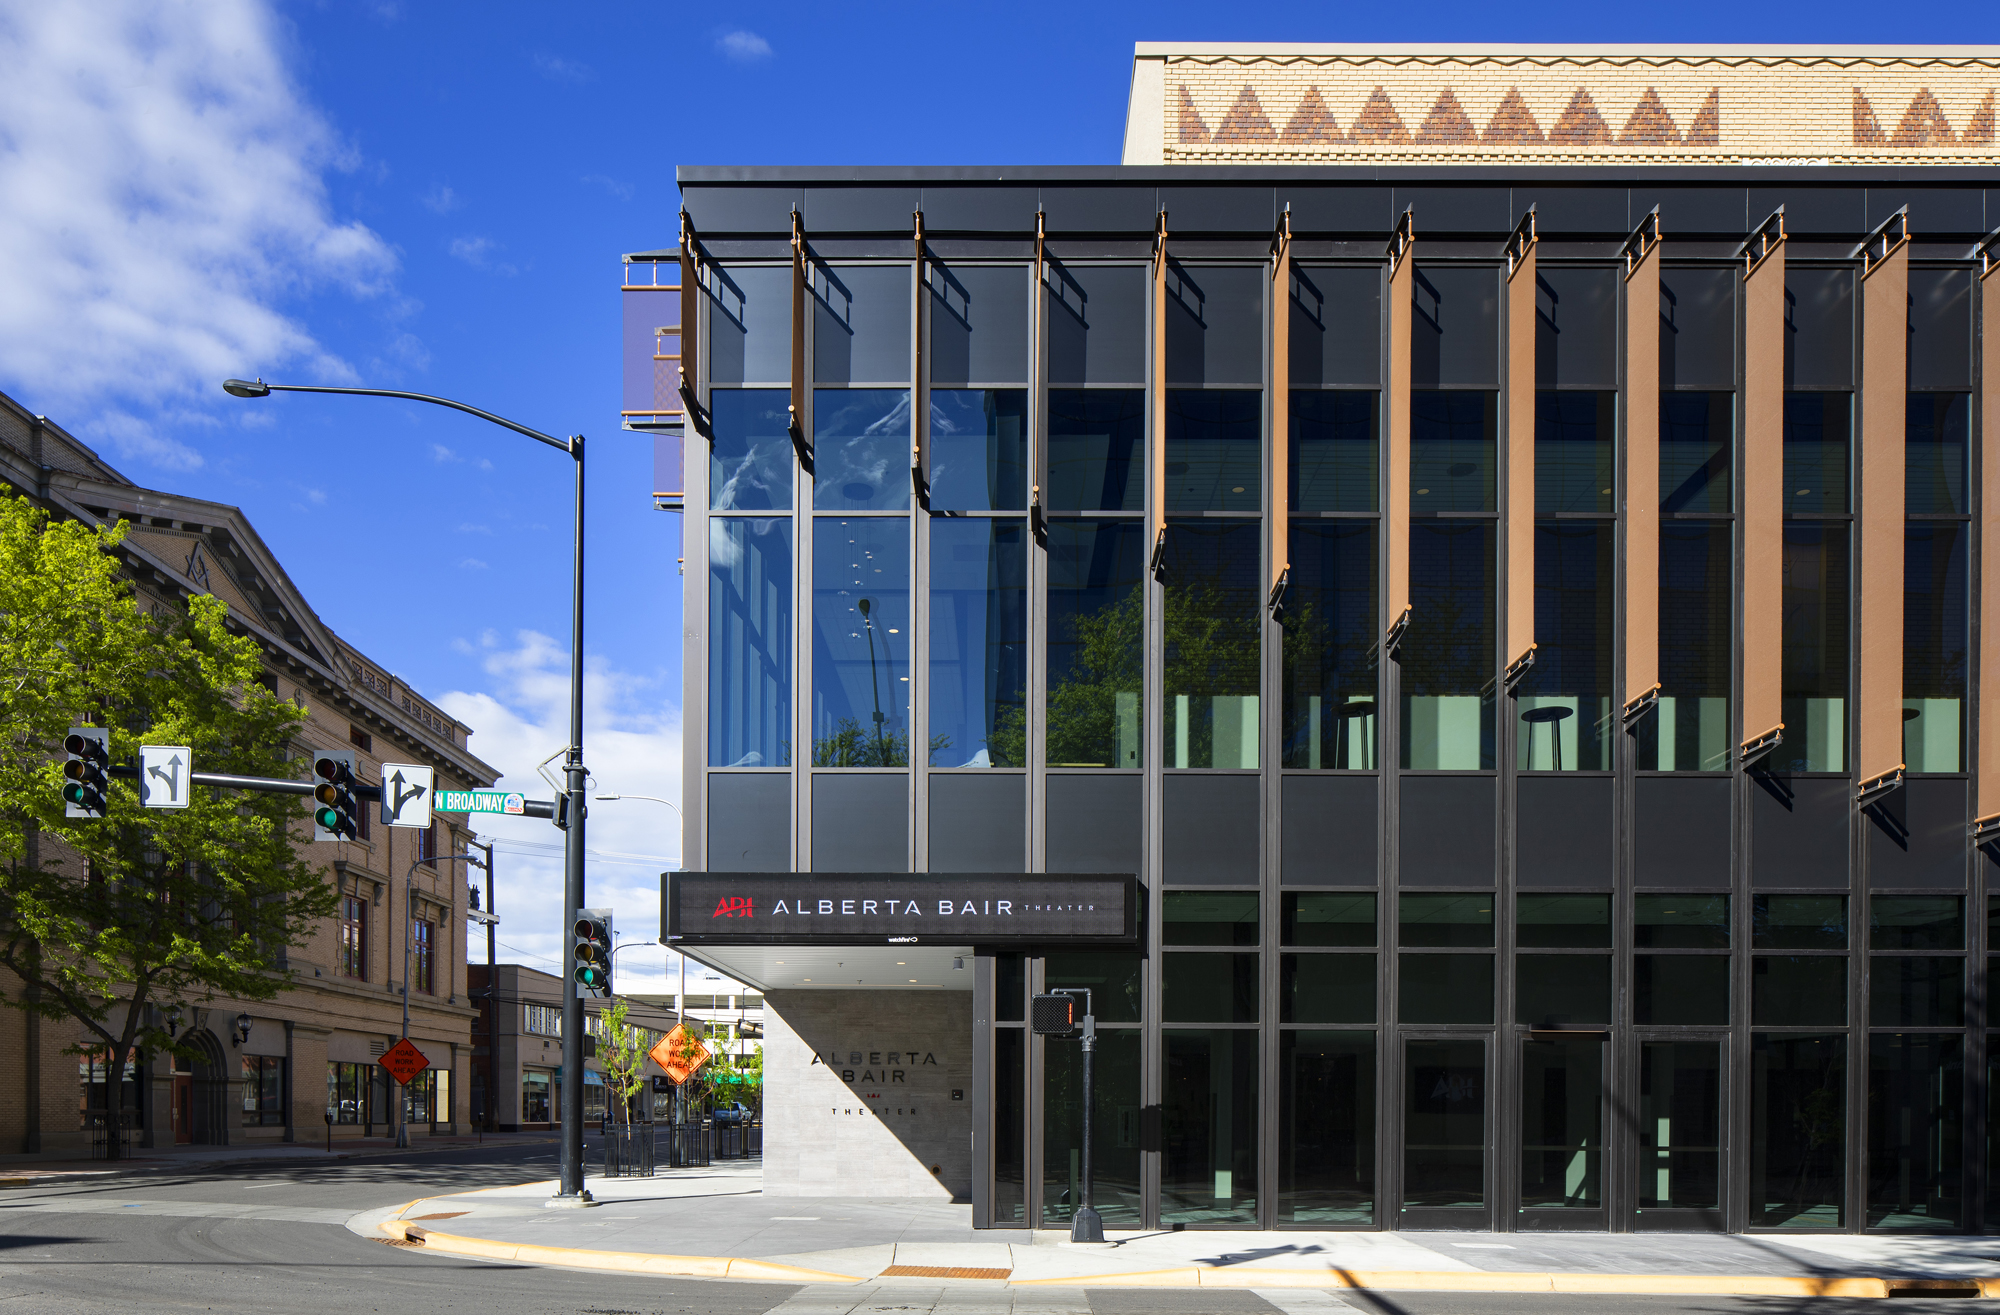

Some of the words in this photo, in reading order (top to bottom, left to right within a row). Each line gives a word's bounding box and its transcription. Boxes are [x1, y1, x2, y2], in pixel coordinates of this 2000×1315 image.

[435, 792, 443, 809] N
[446, 792, 504, 812] BROADWAY
[772, 899, 922, 915] ALBERTA
[938, 899, 1012, 915] BAIR
[811, 1052, 937, 1066] ALBERTA
[842, 1070, 905, 1082] BAIR
